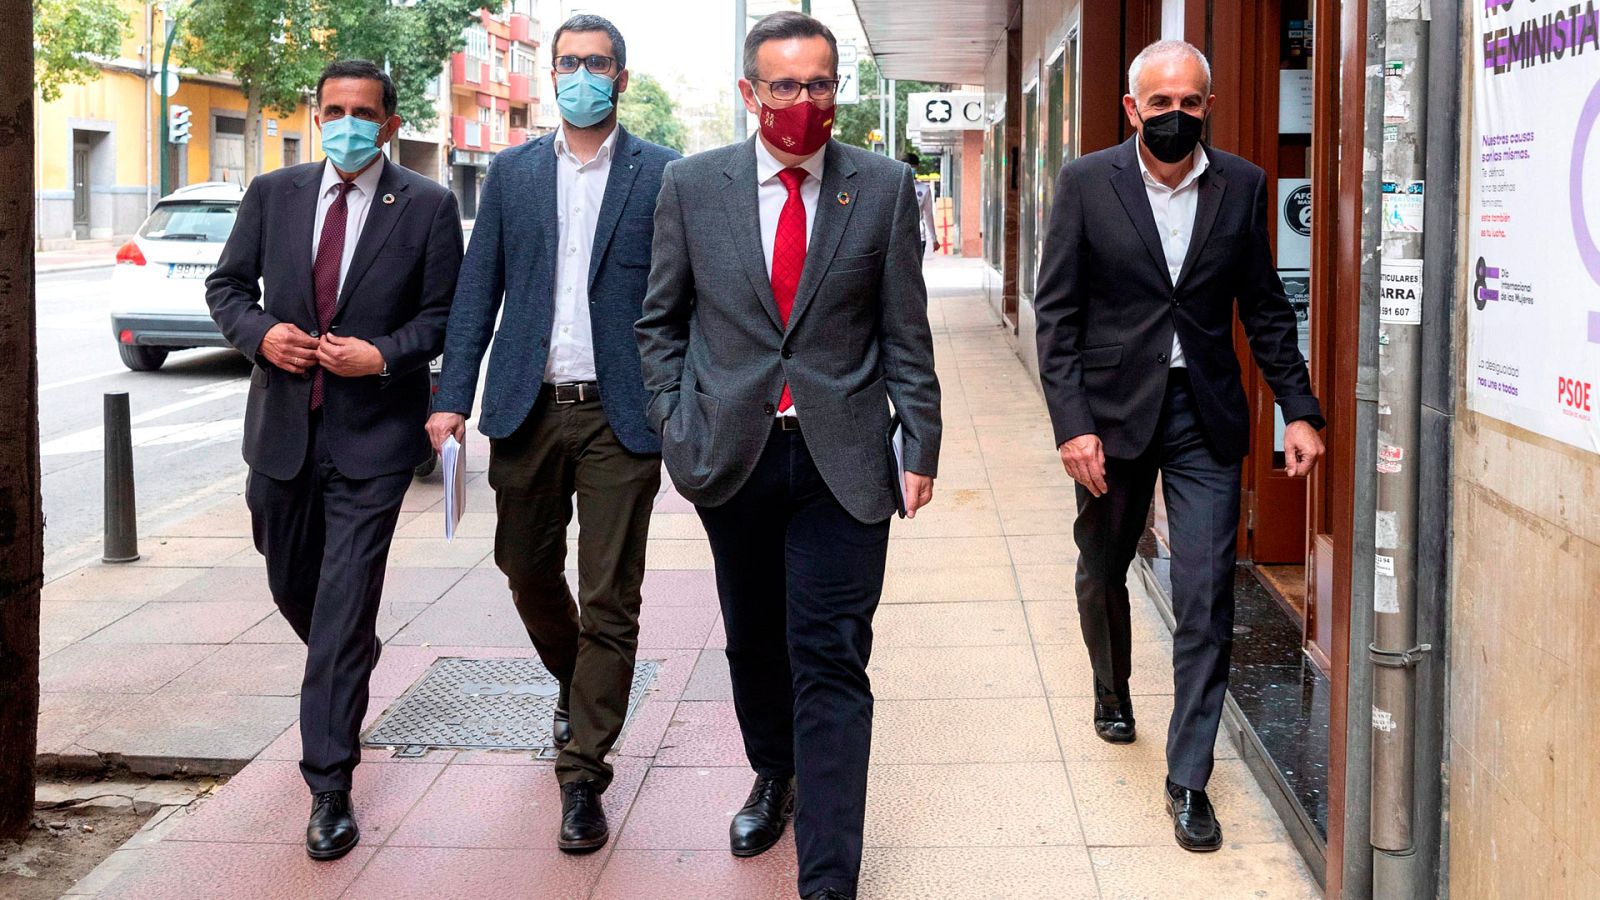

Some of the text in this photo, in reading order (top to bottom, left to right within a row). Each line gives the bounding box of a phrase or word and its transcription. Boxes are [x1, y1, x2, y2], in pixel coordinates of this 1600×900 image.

[1483, 0, 1599, 75] FEMINISTA
[963, 101, 982, 122] C
[1482, 131, 1534, 147] Nuestras causas
[1558, 375, 1591, 412] PSOE
